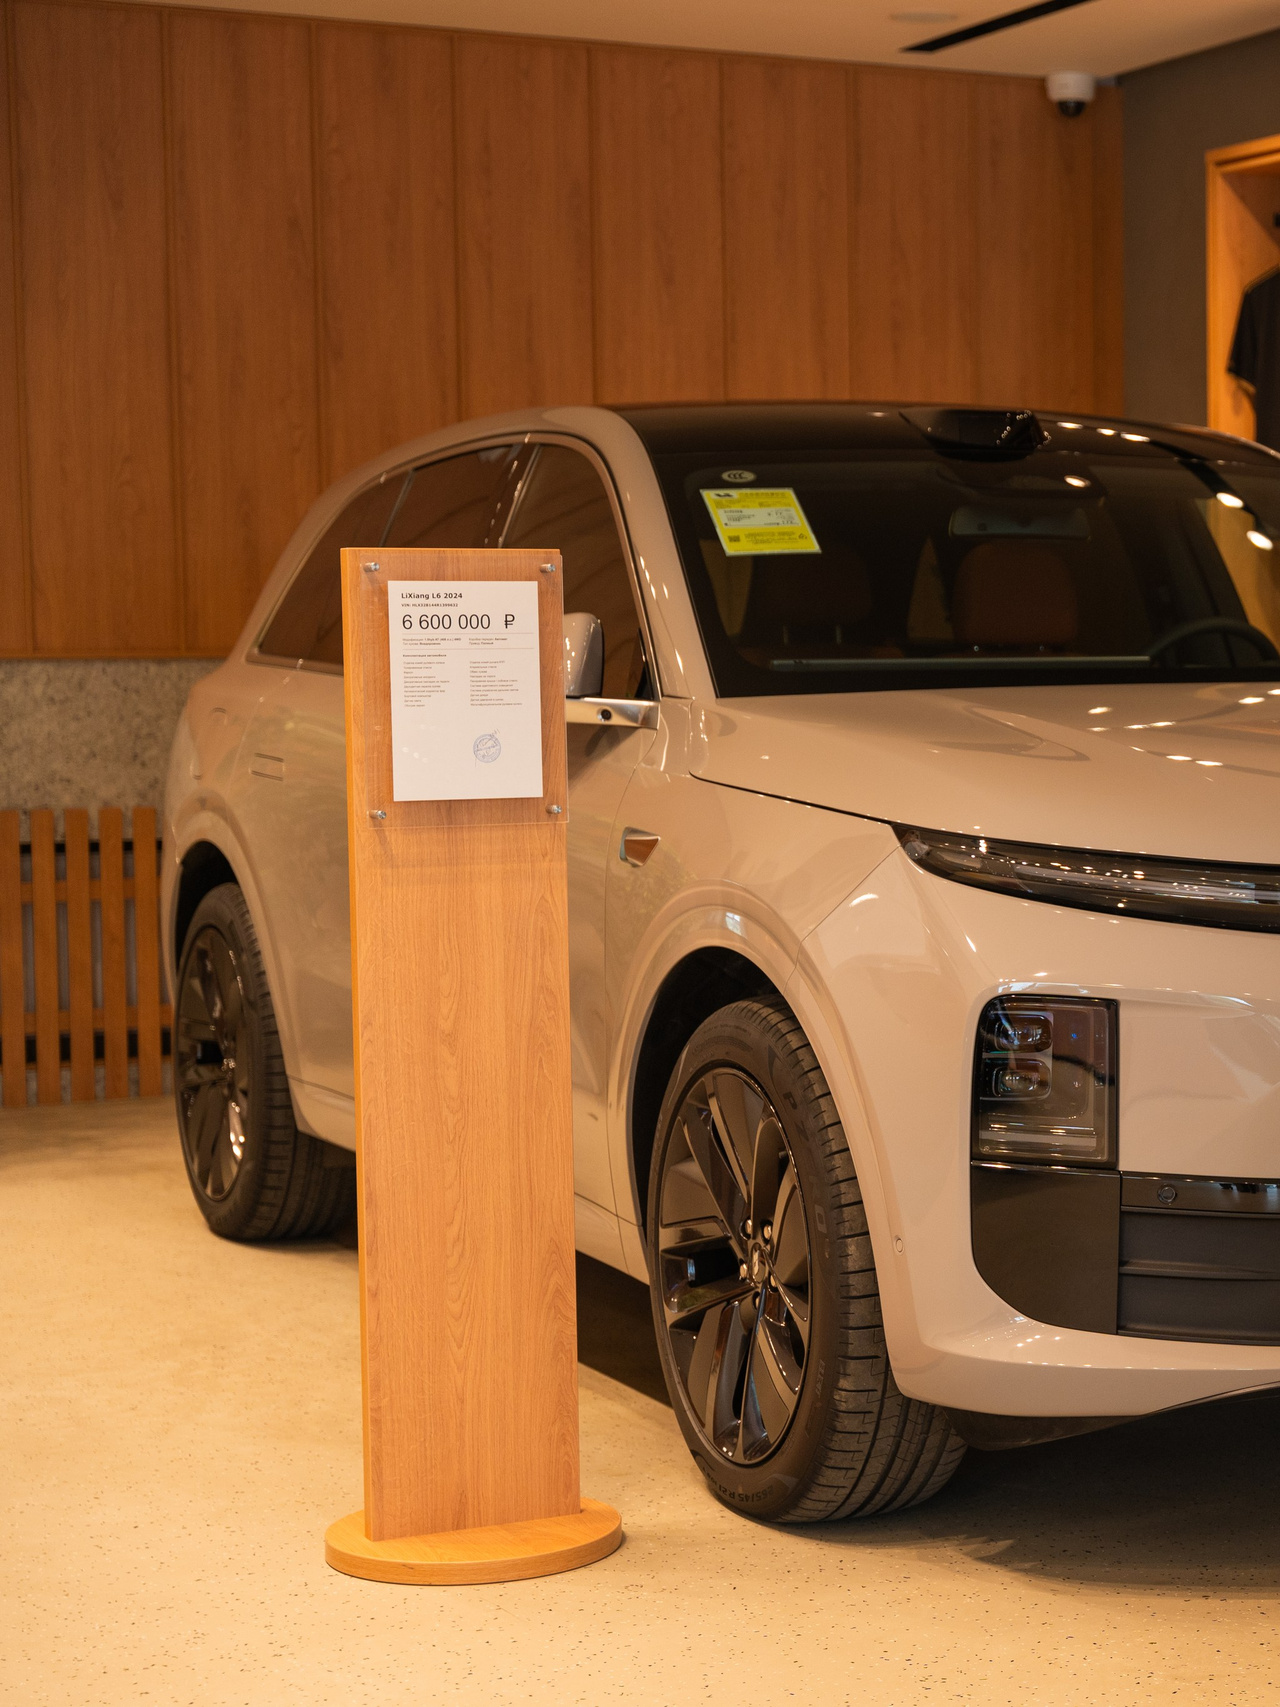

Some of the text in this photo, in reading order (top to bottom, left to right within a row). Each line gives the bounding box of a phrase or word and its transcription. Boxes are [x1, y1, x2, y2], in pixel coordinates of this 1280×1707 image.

[401, 592, 430, 600] LiXiang
[402, 614, 413, 630] 6
[419, 614, 452, 630] 600
[458, 614, 491, 630] 000
